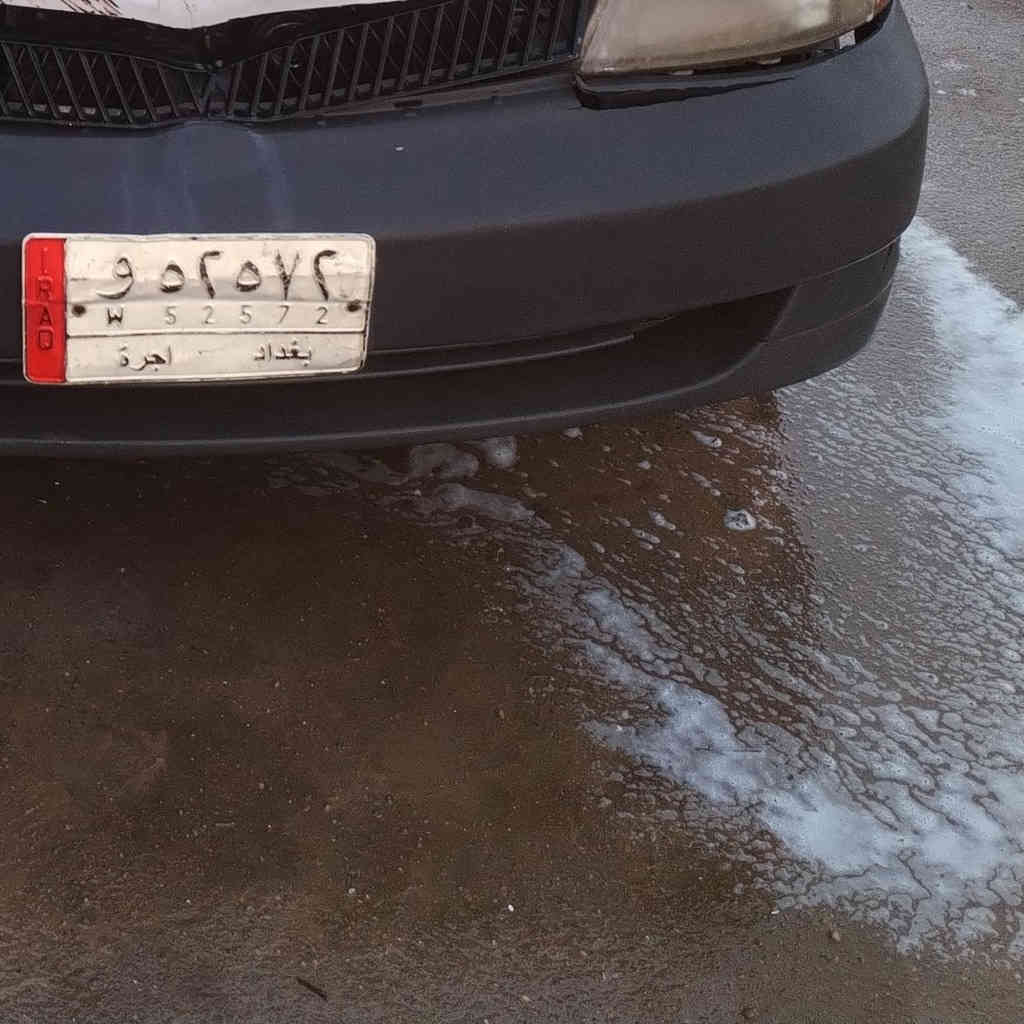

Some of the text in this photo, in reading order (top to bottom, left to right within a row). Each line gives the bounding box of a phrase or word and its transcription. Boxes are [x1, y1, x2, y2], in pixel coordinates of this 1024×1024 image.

[38, 246, 55, 351] IRAQ
[106, 305, 329, 326] W 52572
[254, 341, 312, 368] بغداد
